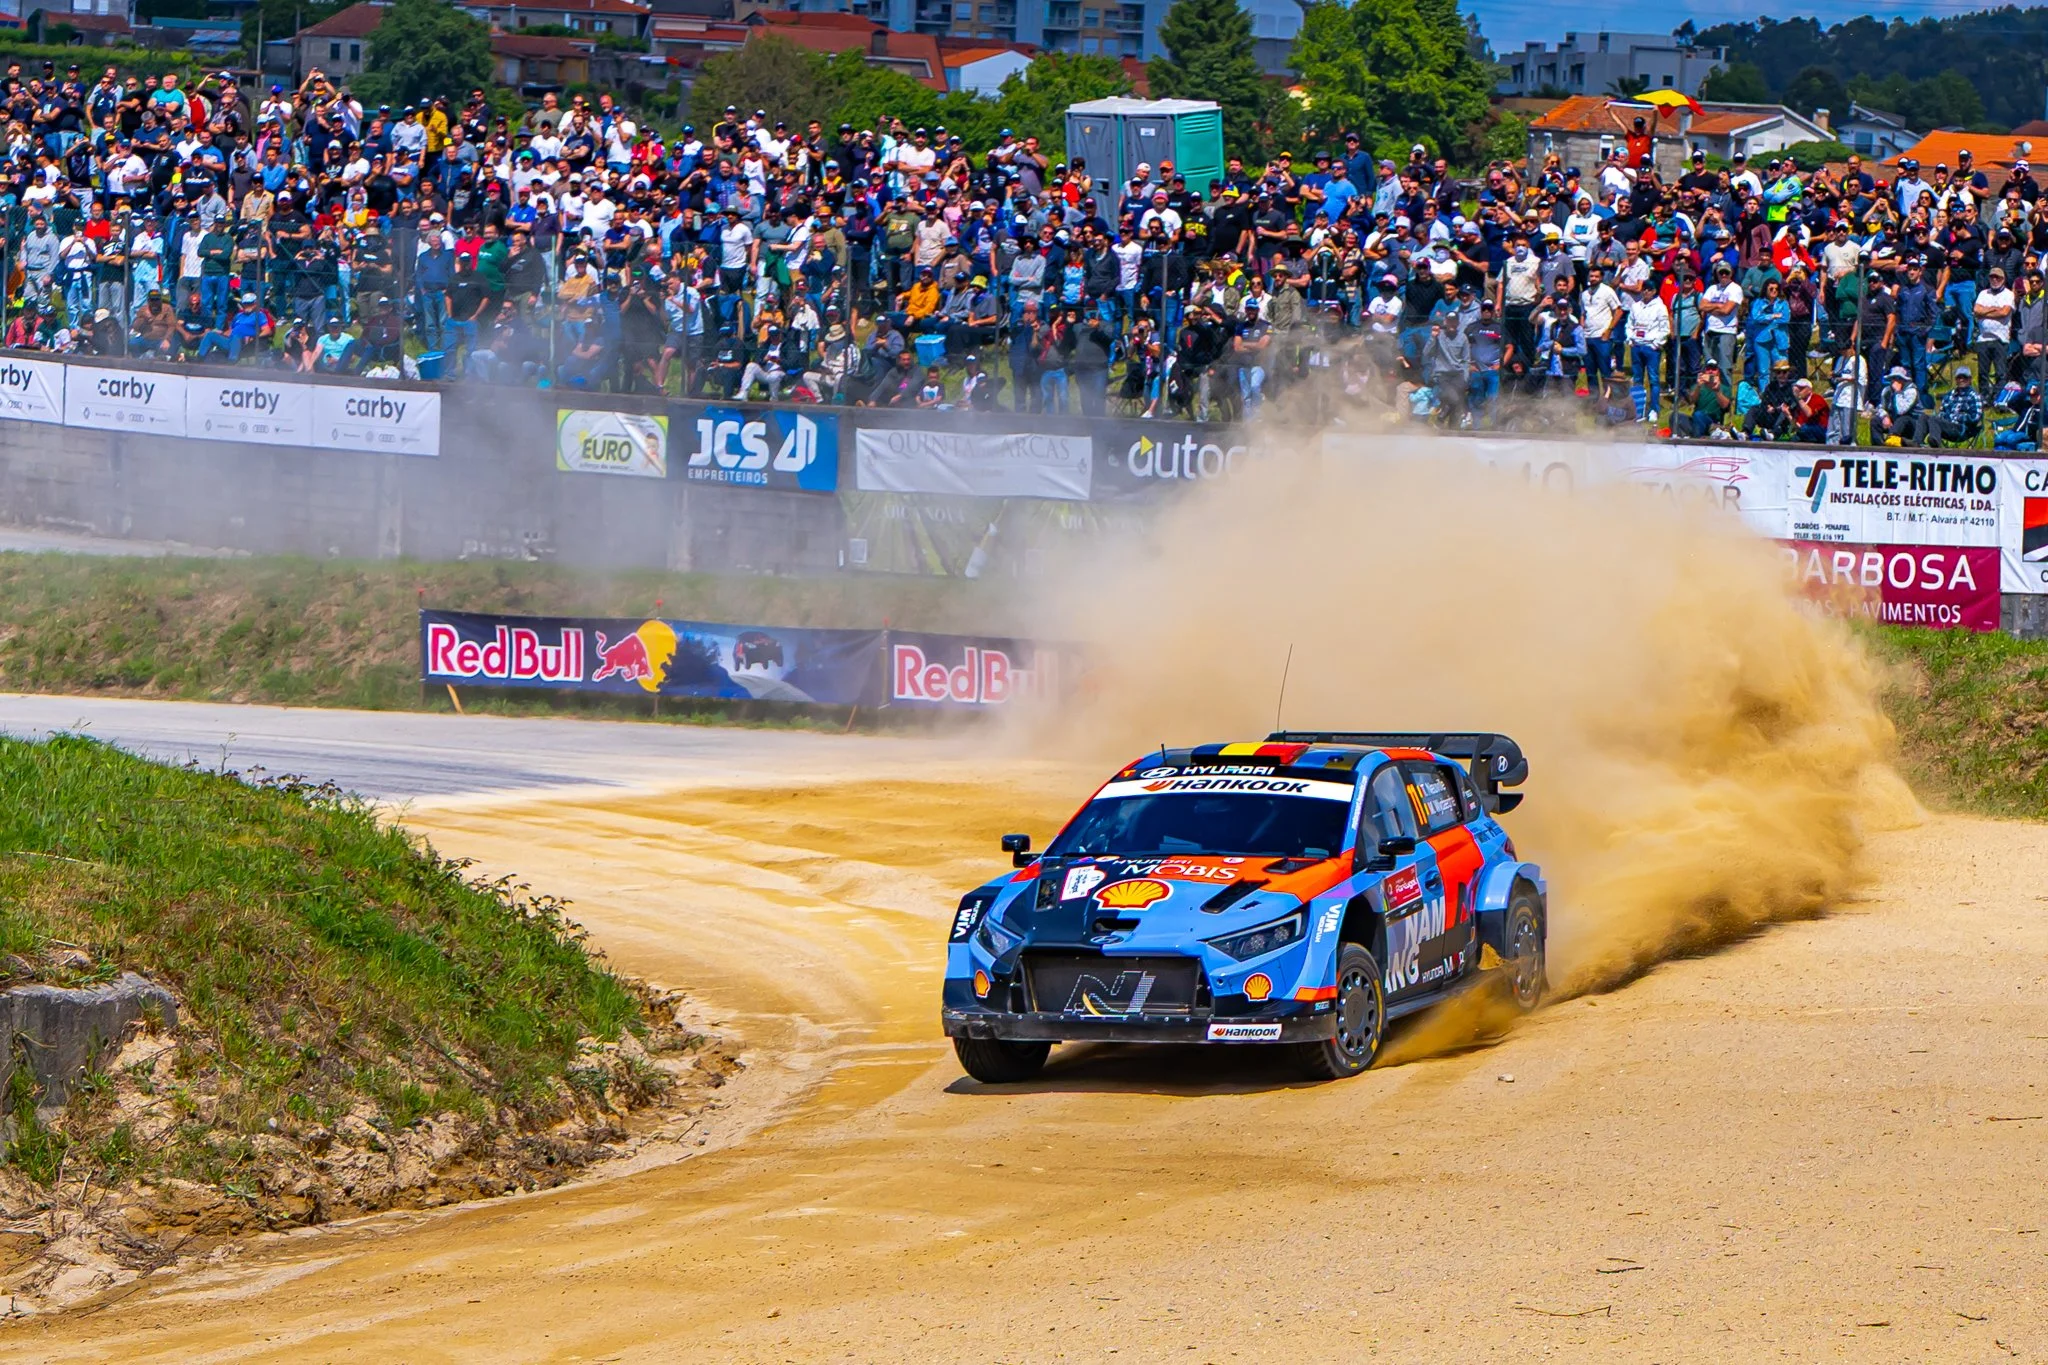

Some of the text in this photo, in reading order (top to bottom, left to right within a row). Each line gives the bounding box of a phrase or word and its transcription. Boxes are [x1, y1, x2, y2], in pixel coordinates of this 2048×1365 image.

[97, 376, 156, 404] carby
[219, 387, 280, 415] carby
[345, 395, 406, 423] carby
[581, 438, 632, 462] EURO
[688, 418, 770, 469] JCS
[888, 432, 976, 460] QUINTA
[688, 467, 769, 484] EMPREITEIROS
[1840, 458, 1997, 495] TELE-RITMO
[1830, 491, 1996, 512] INSTALAÇÕES ELÉCTRICAS, LDA.
[1886, 511, 1902, 522] B.T.
[1908, 512, 1925, 524] M.T.
[1931, 513, 1960, 525] Alvará
[1969, 517, 1995, 527] 42110
[1850, 600, 1961, 623] PAVIMENTOS
[1182, 765, 1276, 775] HYUNDAI
[1120, 864, 1240, 880] MOBIS
